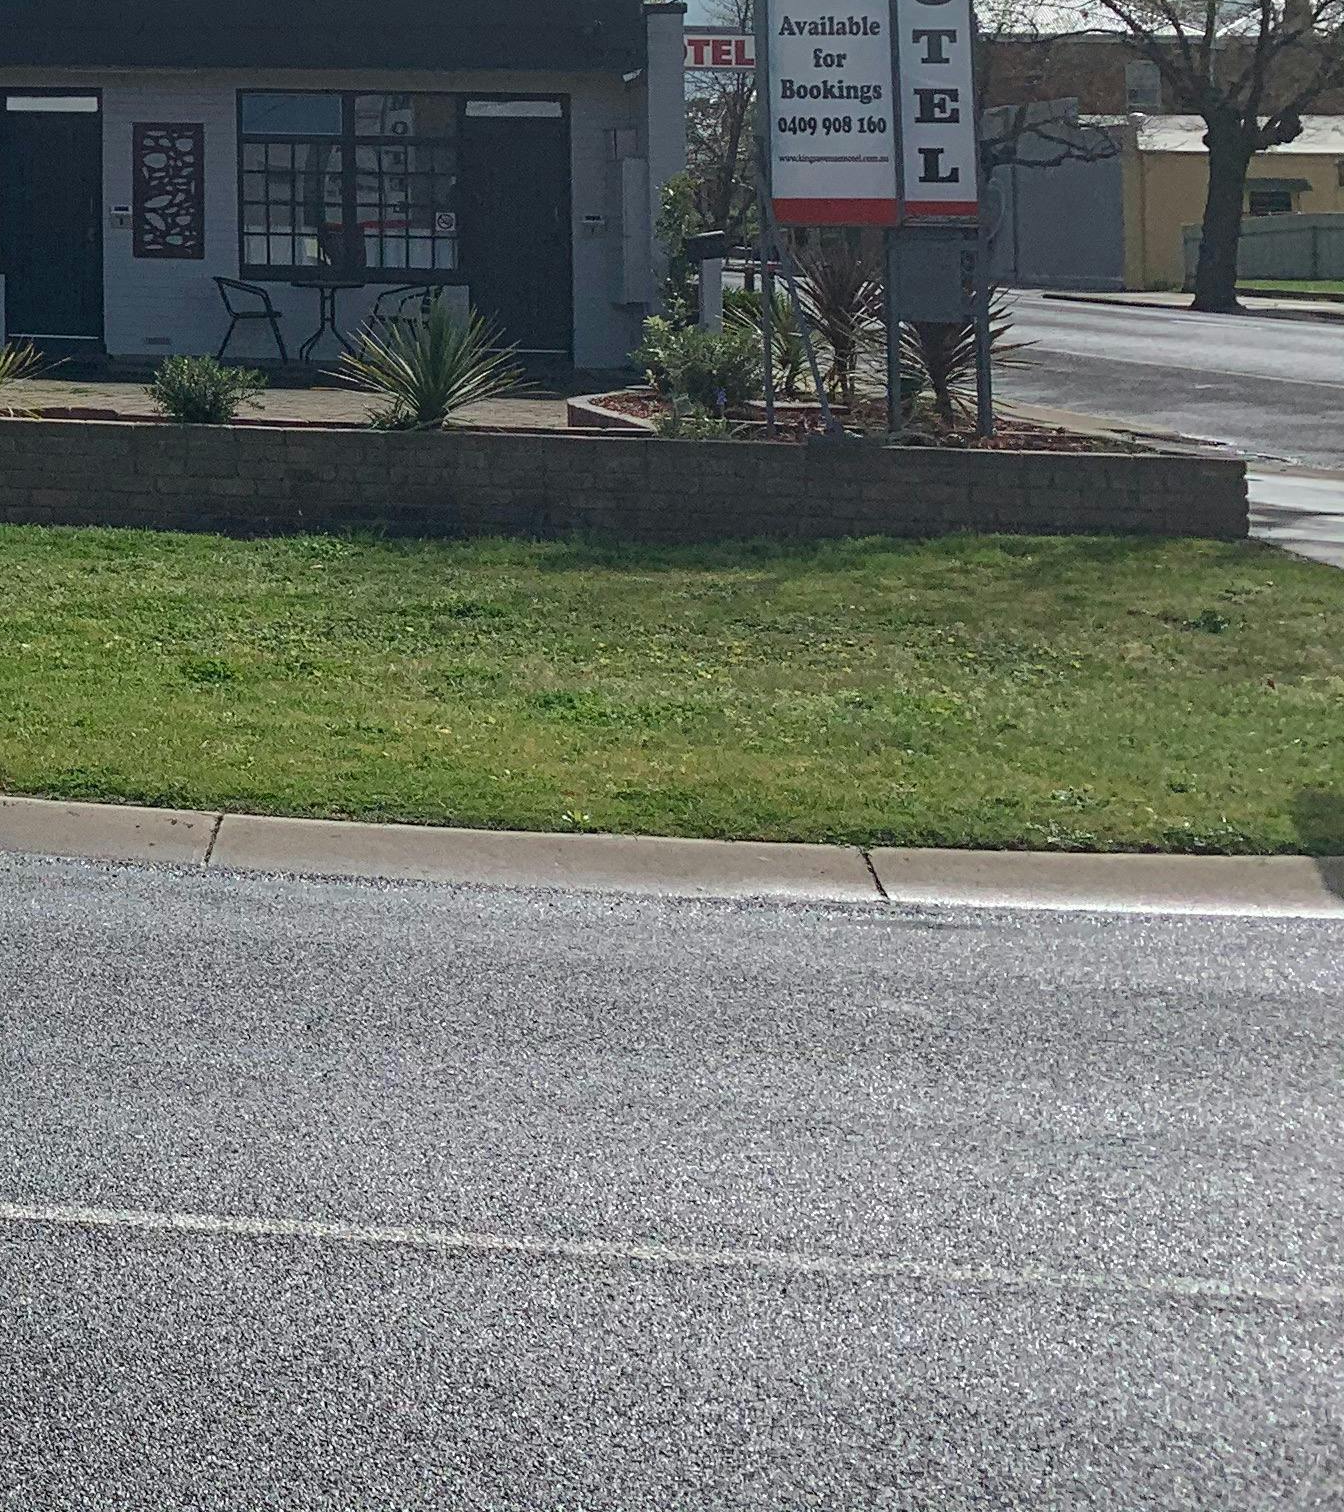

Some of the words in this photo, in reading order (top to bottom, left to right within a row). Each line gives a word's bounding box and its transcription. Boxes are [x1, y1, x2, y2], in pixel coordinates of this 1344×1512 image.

[778, 15, 881, 36] Available
[683, 39, 755, 65] TEL
[813, 48, 847, 68] for
[780, 79, 882, 104] Bookings
[778, 116, 817, 136] 0409
[822, 116, 852, 136] 908
[857, 116, 887, 134] 160
